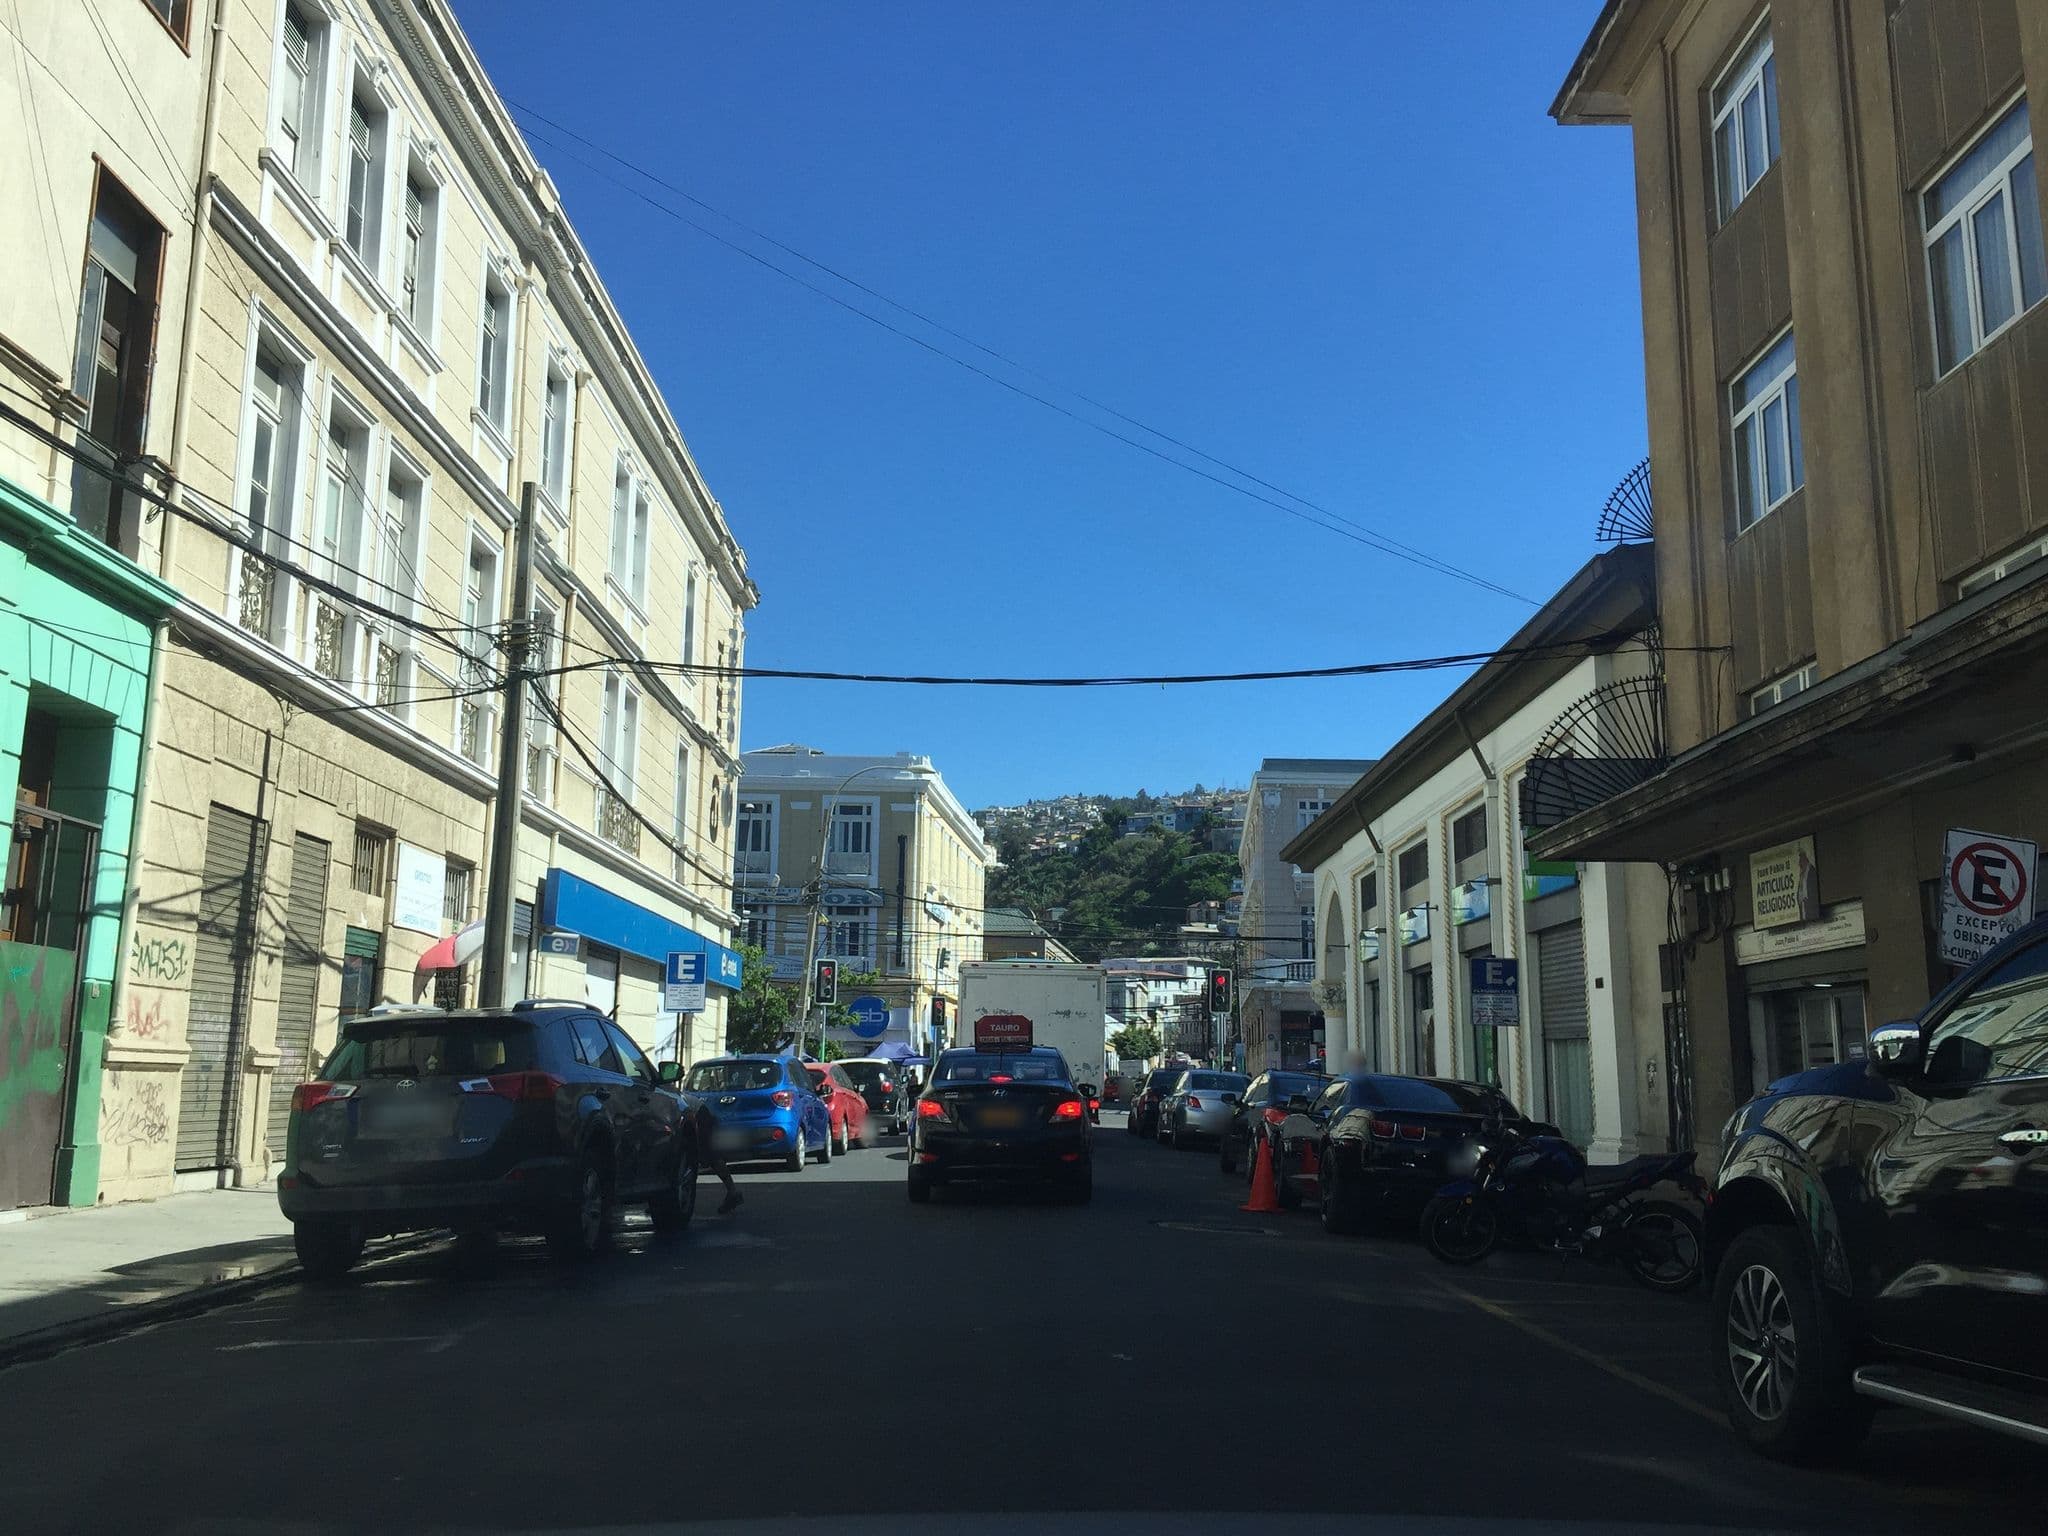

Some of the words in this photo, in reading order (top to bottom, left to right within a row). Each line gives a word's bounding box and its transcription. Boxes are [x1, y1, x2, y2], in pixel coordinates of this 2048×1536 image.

[1757, 873, 1795, 898] ARTICULOS
[1973, 855, 2007, 906] E
[1757, 893, 1796, 916] RELIGIOSOS
[1956, 914, 2015, 934] EXCEPTO
[677, 954, 696, 980] E
[1486, 961, 1504, 985] E
[990, 1024, 1020, 1032] TAURO
